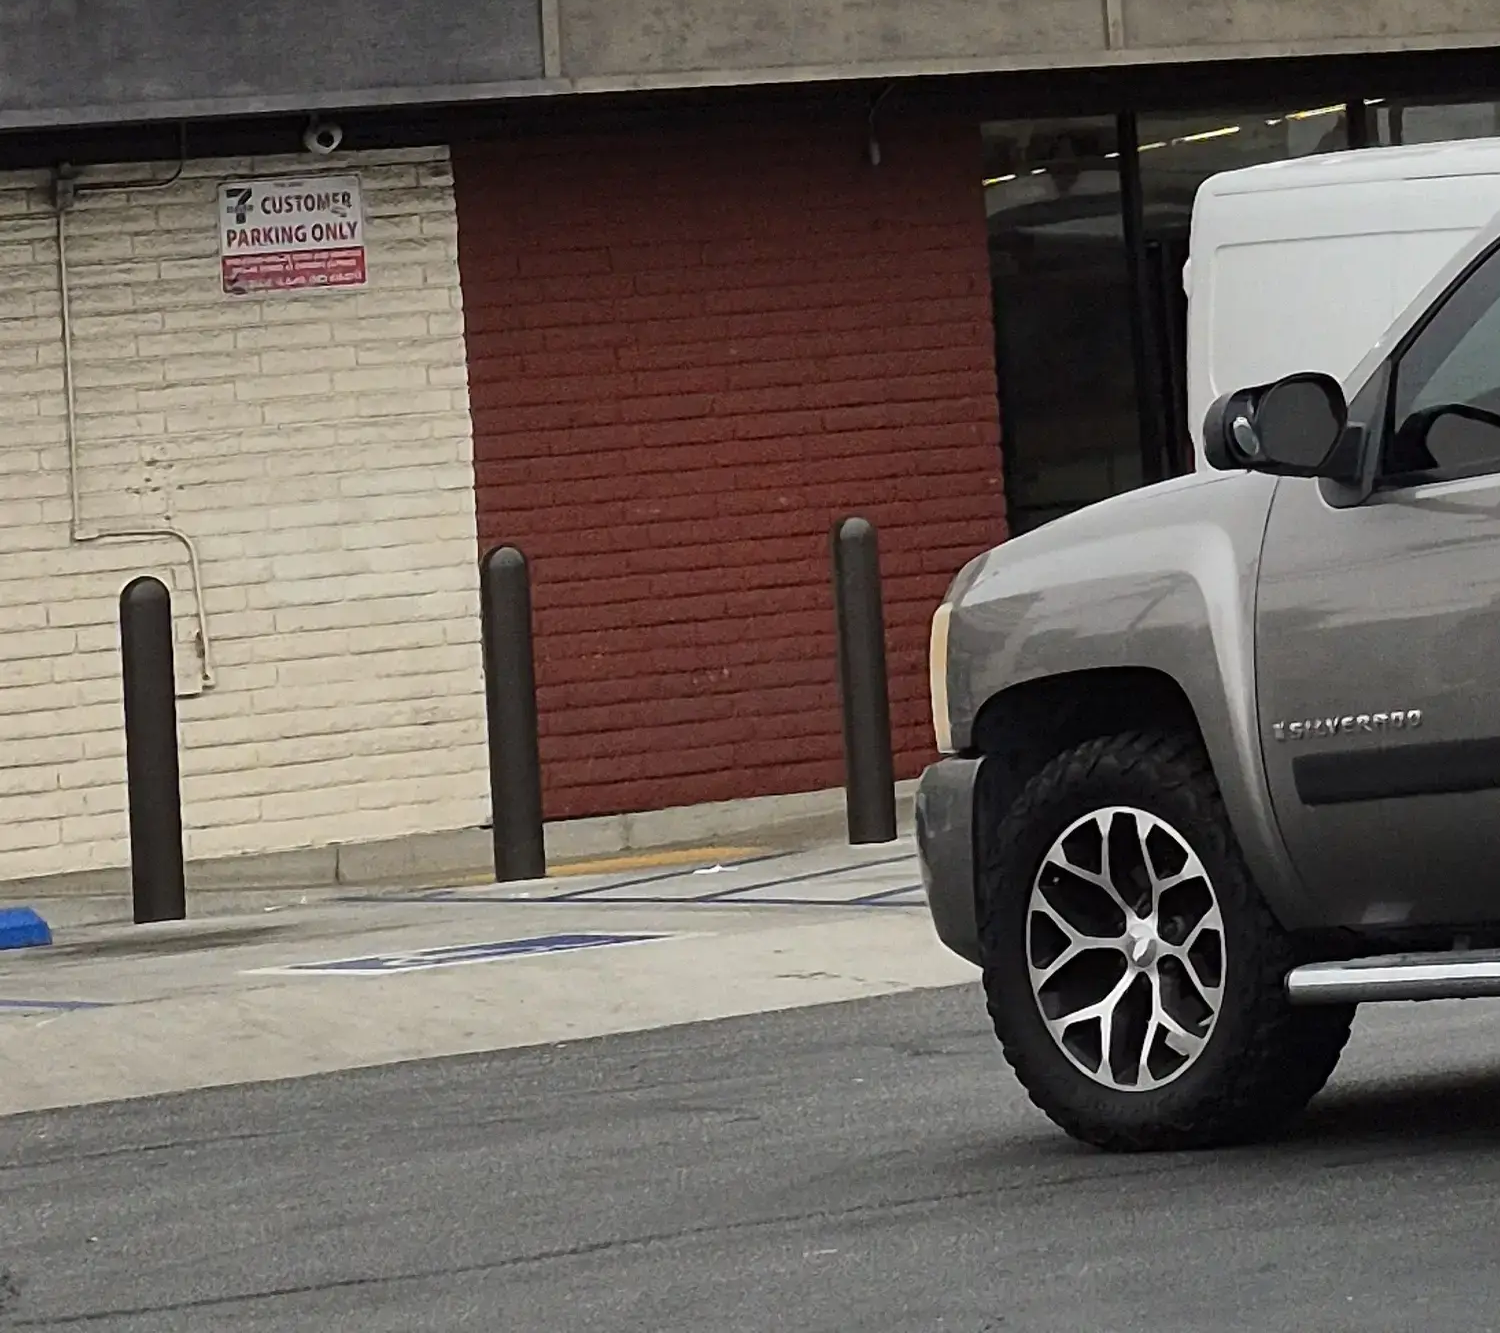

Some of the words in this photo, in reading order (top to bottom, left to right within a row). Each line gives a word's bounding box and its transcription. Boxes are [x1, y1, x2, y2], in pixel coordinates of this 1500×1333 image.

[260, 191, 353, 215] CUSTOMER
[226, 224, 307, 247] PARKING
[311, 219, 358, 243] ONLY
